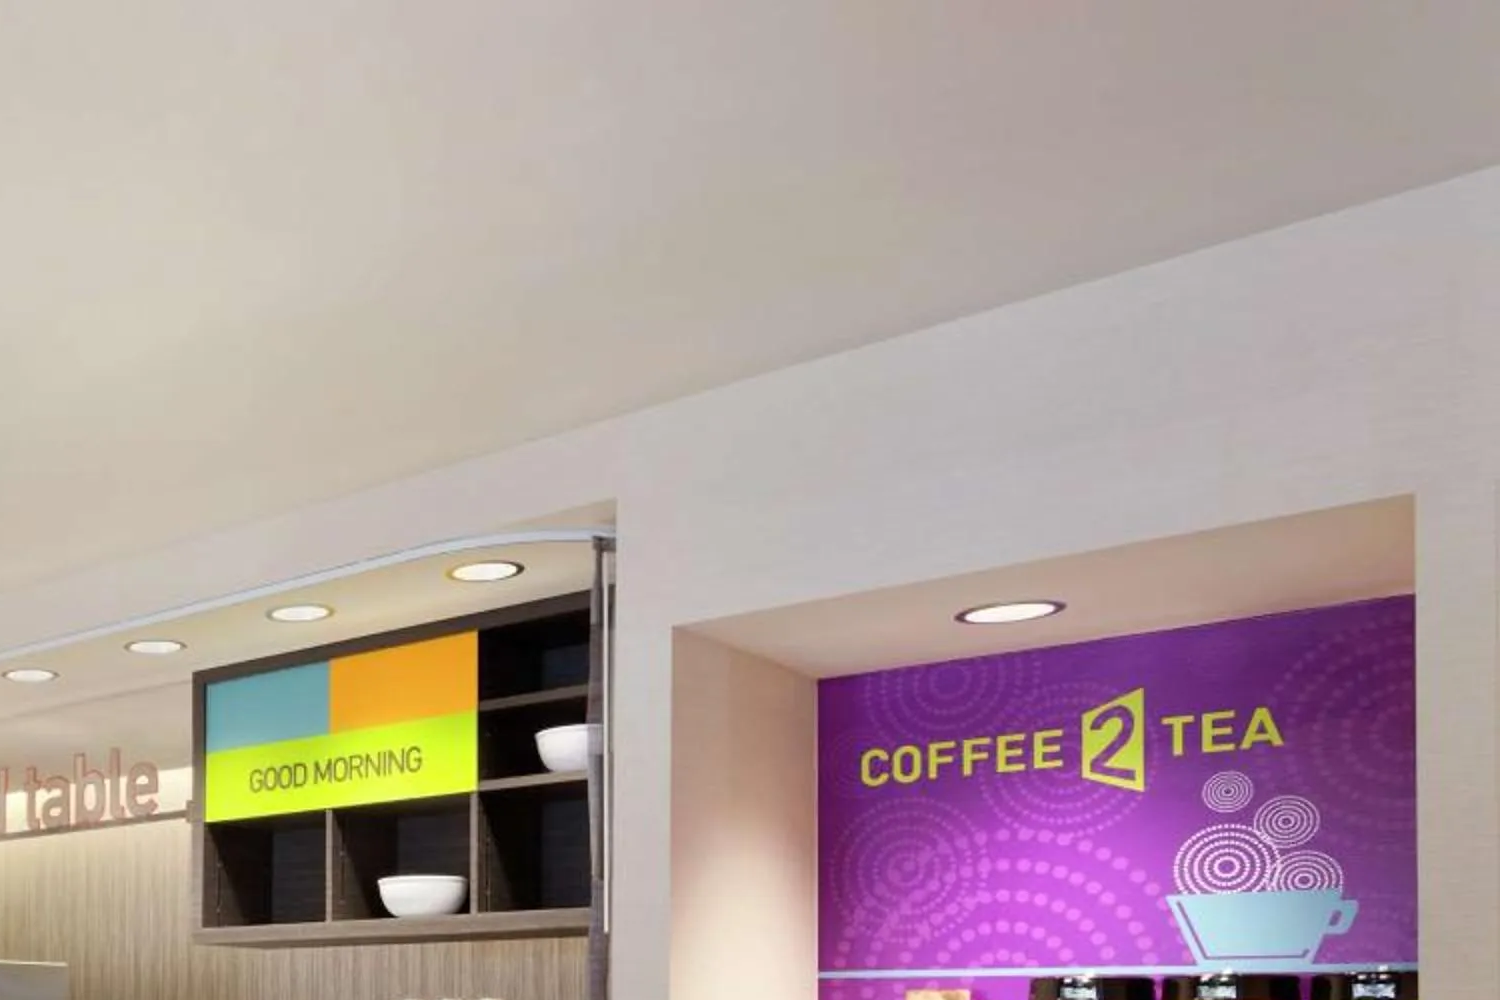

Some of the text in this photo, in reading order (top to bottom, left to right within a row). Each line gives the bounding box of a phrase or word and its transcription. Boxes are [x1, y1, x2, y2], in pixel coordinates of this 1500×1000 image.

[249, 745, 423, 793] GOOD MORNING
[860, 703, 1284, 787] COFFEE 2 TEA
[24, 747, 159, 832] table
